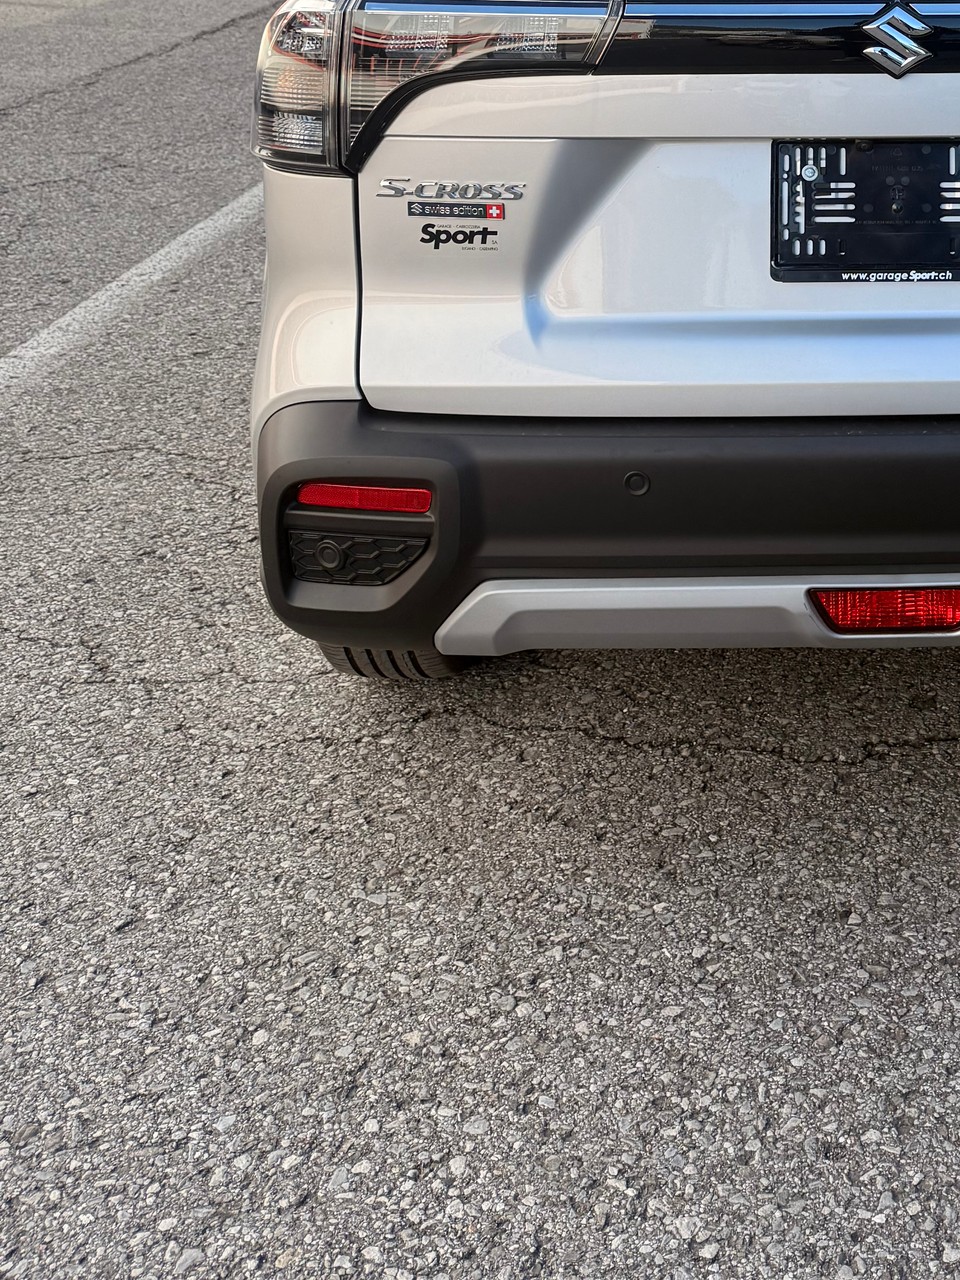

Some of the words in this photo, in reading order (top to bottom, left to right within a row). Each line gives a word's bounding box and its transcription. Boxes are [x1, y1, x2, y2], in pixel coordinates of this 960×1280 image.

[376, 176, 526, 200] S-CROSS
[424, 205, 451, 215] swiss
[453, 205, 484, 216] edition
[420, 223, 498, 250] Sport
[841, 270, 953, 282] www.garageSport.ch
